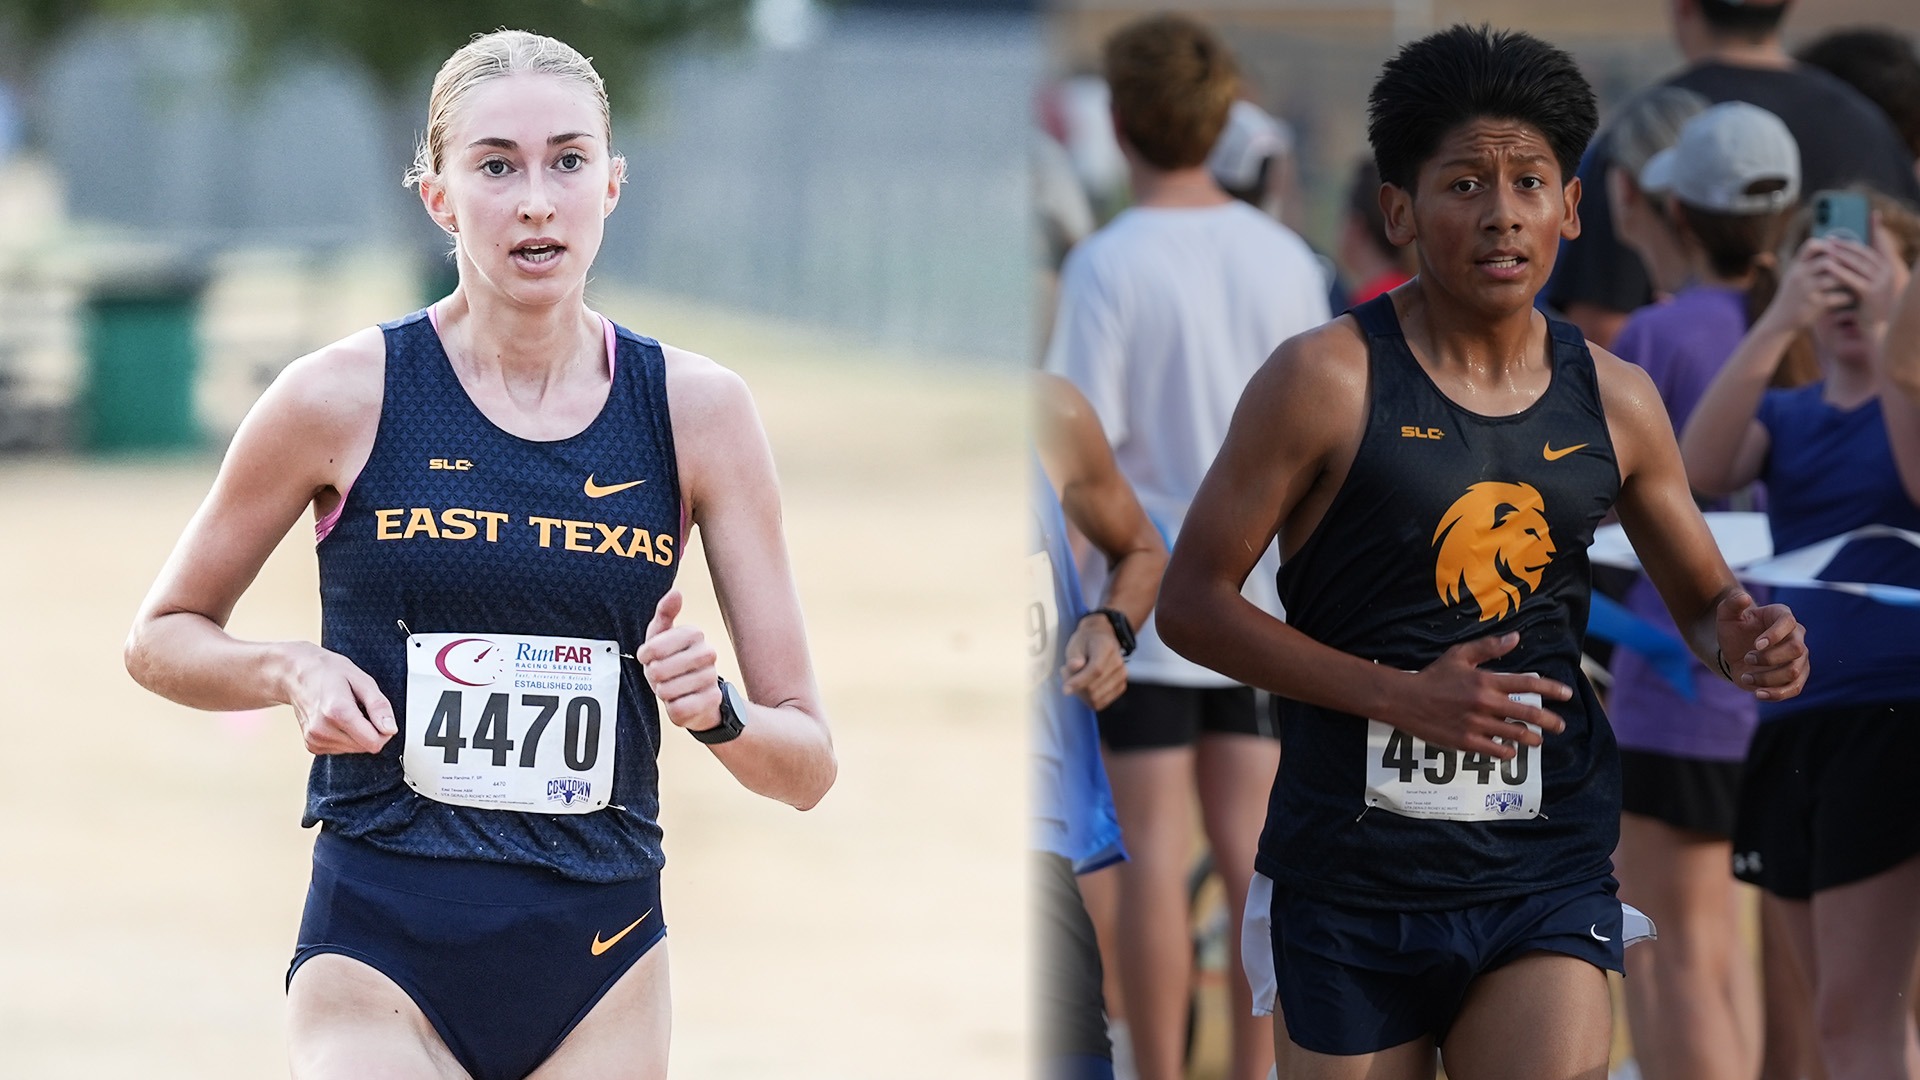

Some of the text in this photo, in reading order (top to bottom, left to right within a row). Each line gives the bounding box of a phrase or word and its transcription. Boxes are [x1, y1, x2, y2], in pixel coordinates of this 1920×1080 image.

[375, 508, 674, 567] EAST TEXAS
[515, 642, 592, 664] RunFAR
[552, 664, 592, 672] SERVICES
[514, 680, 573, 690] ESTABLISHED
[424, 690, 601, 772] 4470
[1382, 721, 1529, 785] 4540
[547, 779, 591, 798] COWTOWN
[1485, 792, 1523, 808] COWTOWN
